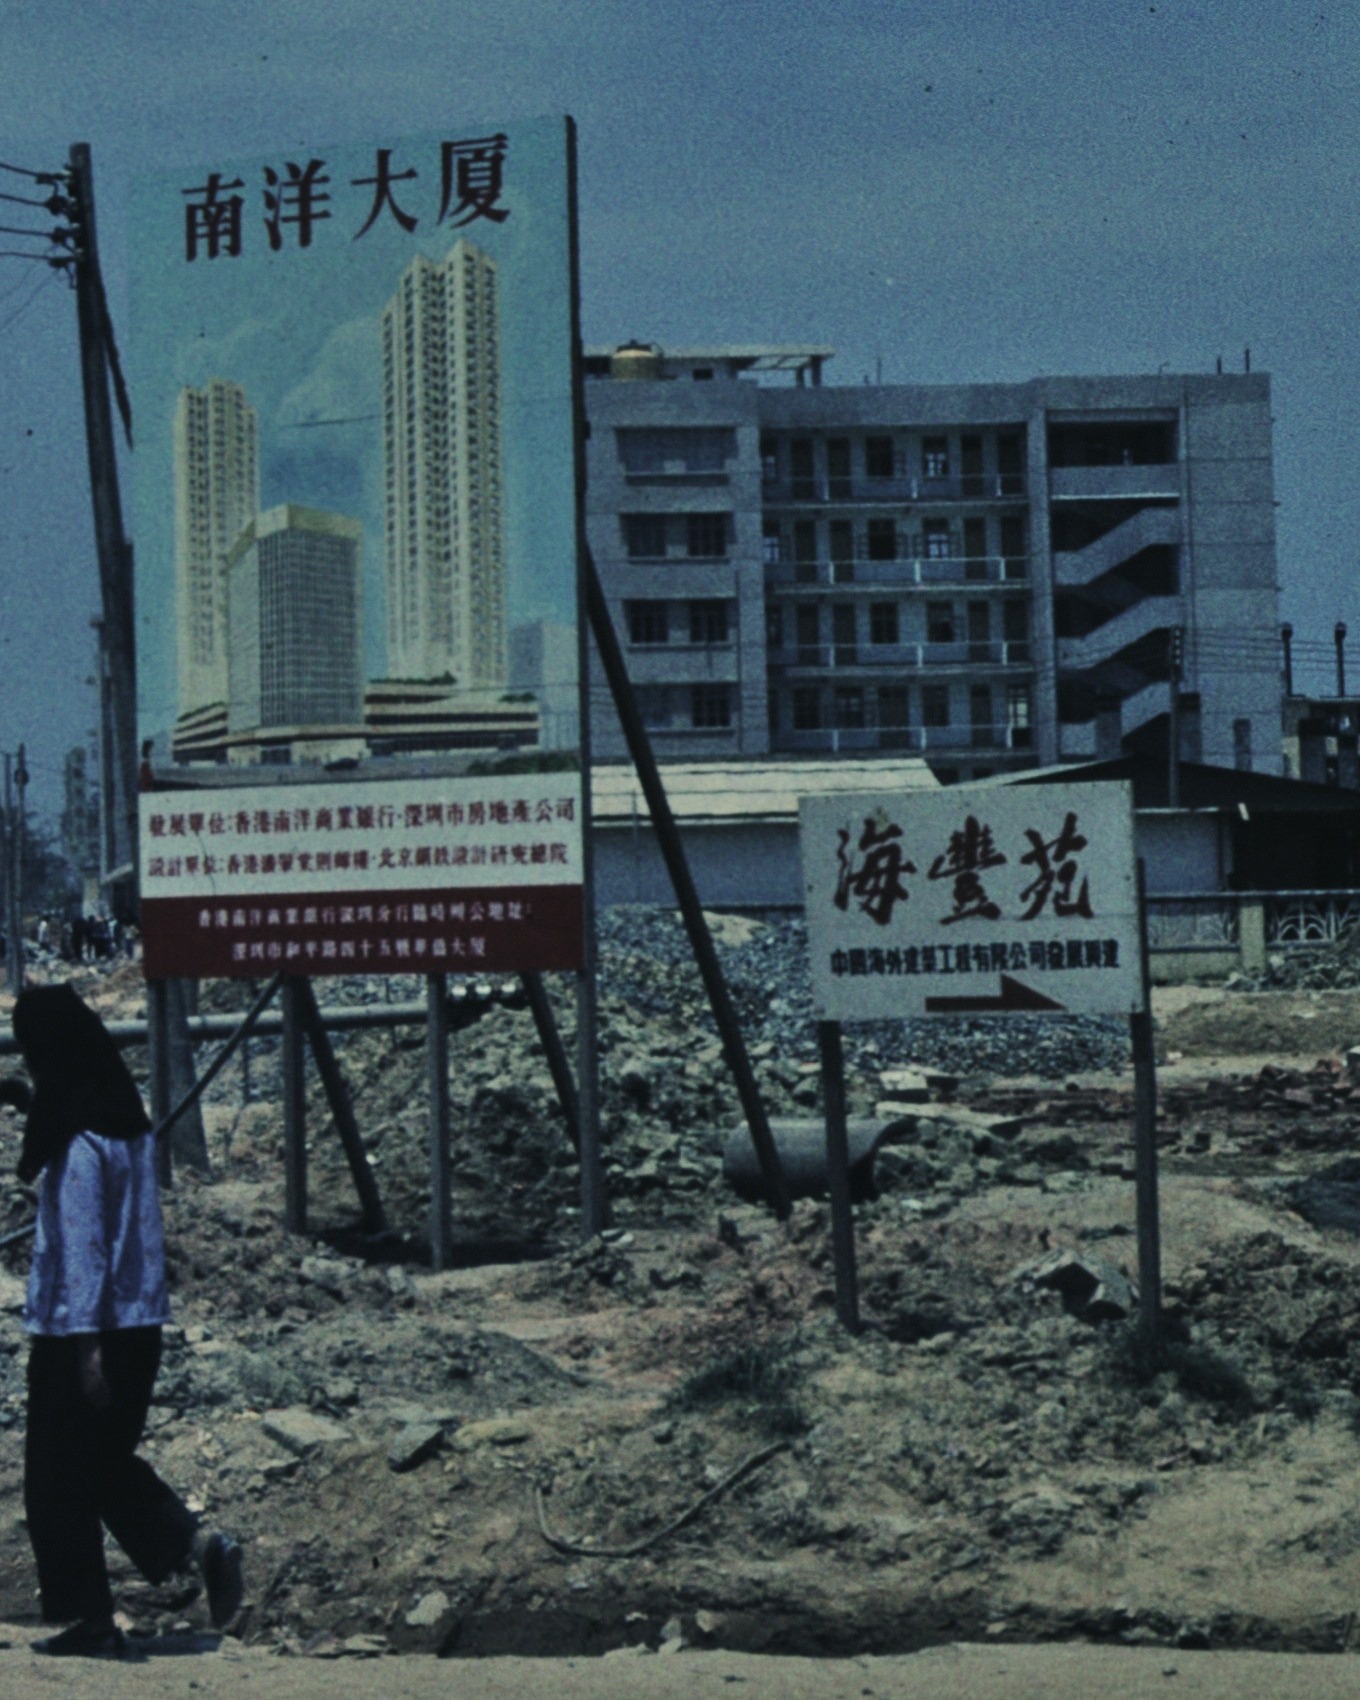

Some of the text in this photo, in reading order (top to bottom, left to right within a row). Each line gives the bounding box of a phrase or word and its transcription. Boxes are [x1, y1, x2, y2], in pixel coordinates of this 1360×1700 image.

[181, 133, 510, 262] 南洋大厦
[834, 811, 1094, 925] 海豐苑
